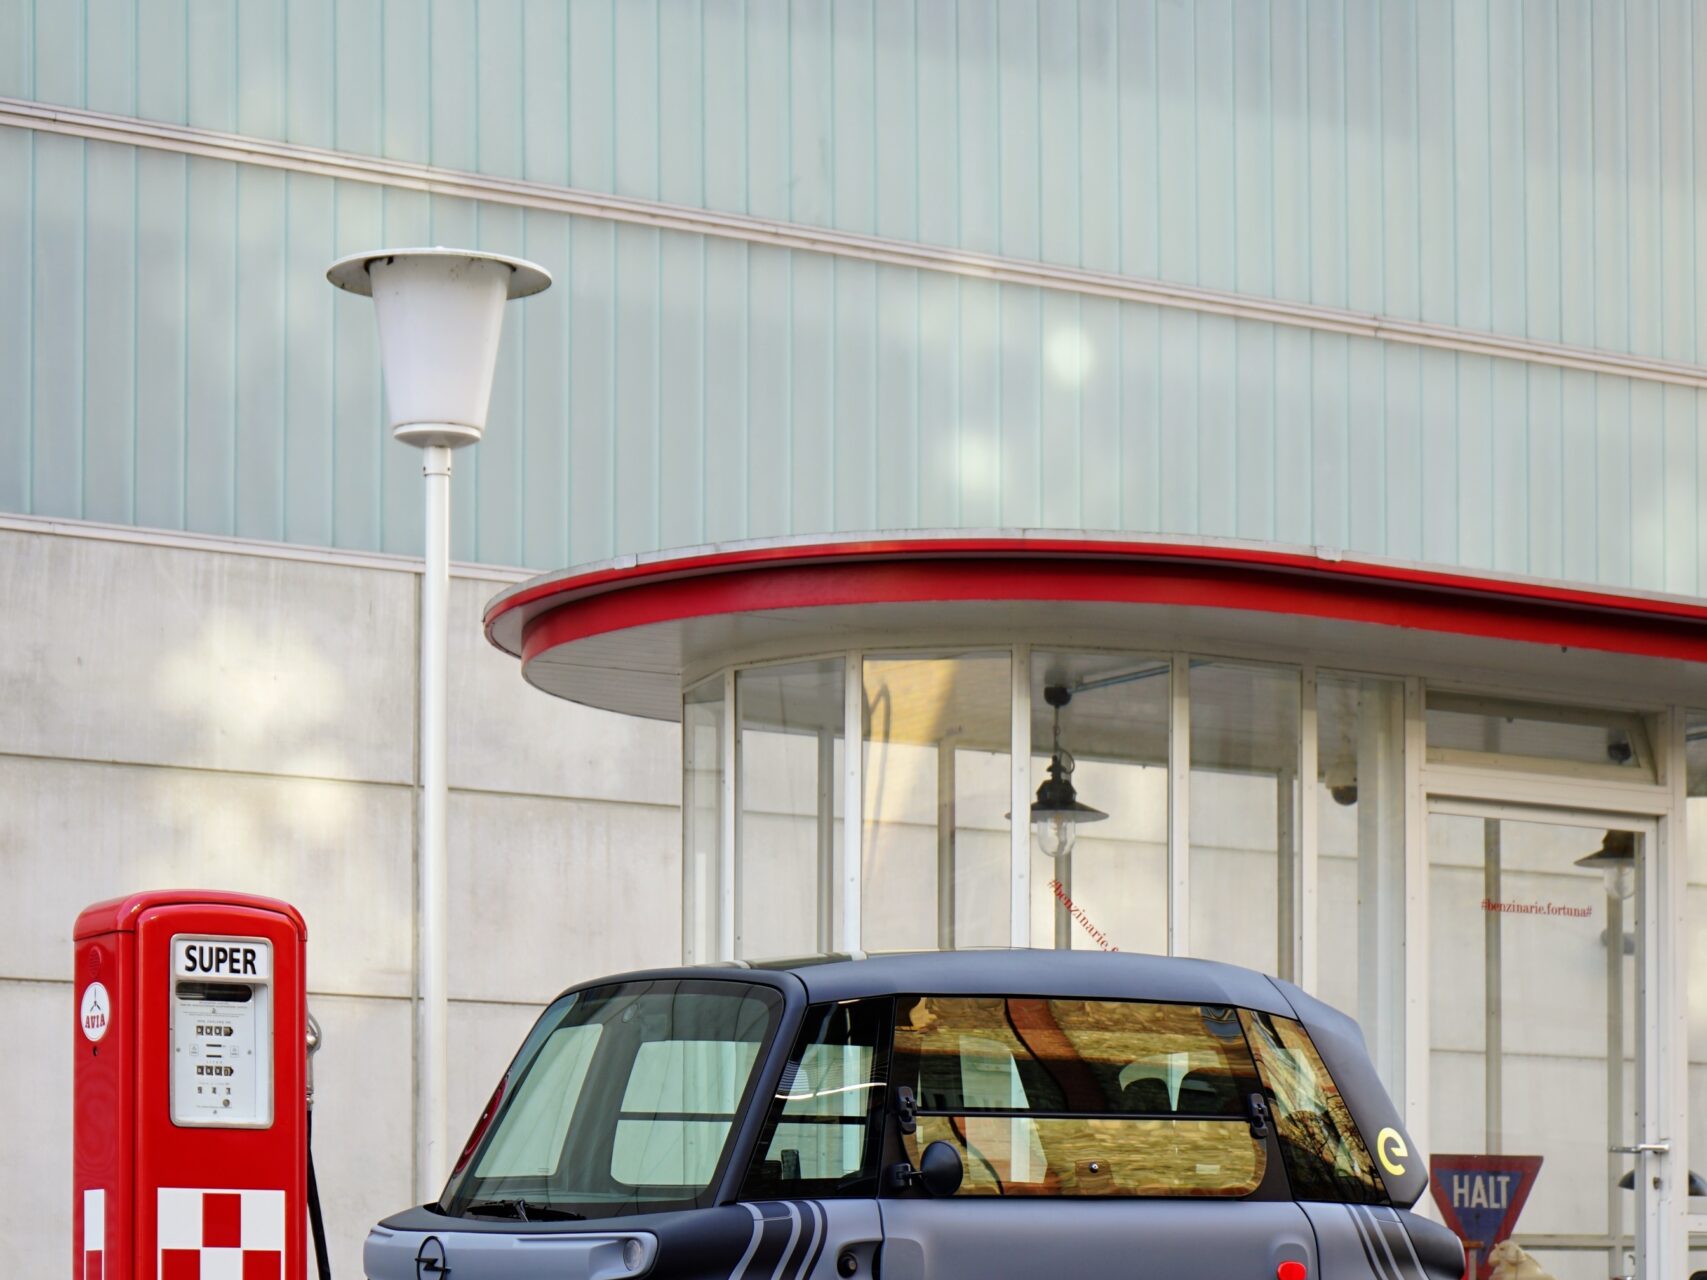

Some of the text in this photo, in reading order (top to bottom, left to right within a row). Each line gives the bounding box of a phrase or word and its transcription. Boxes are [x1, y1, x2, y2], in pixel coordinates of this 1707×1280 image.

[1480, 898, 1592, 917] #benzinarie.fortuna#
[184, 944, 257, 975] SUPER
[85, 1013, 105, 1028] AVIA
[1377, 1127, 1408, 1176] e
[1453, 1174, 1511, 1209] HALT
